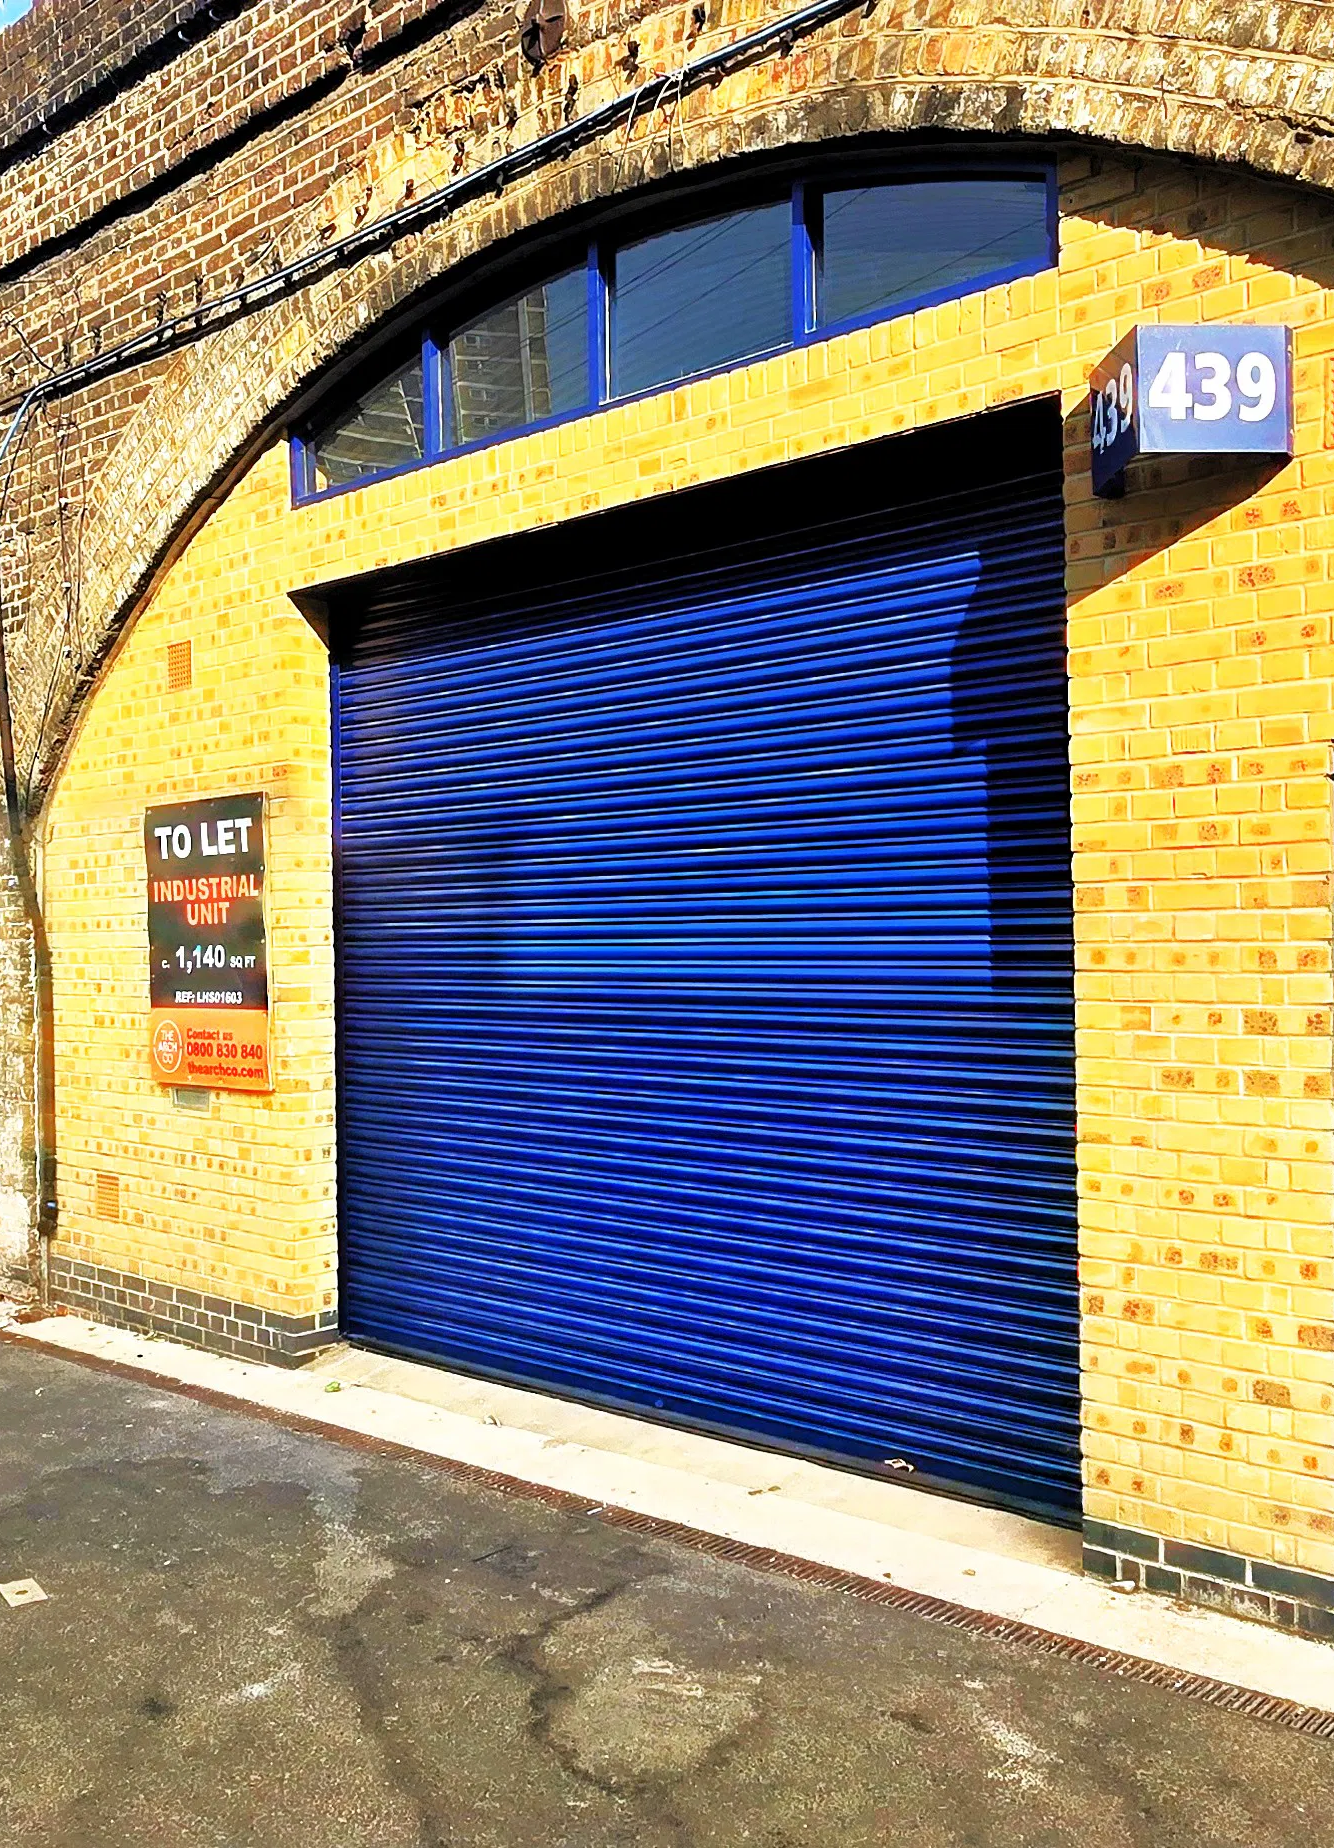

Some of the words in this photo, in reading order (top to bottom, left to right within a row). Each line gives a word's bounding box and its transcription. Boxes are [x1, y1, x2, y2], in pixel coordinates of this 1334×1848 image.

[1149, 351, 1277, 422] 439
[1093, 362, 1133, 454] 439
[154, 824, 192, 860] TO
[200, 817, 253, 857] LET
[153, 874, 259, 902] INDUSTRIAL
[186, 902, 231, 926] UNIT
[175, 944, 226, 974] 1,140
[229, 955, 243, 969] SQ
[244, 955, 256, 969] FT
[174, 990, 196, 1004] REF:
[161, 1029, 175, 1041] THE
[186, 1028, 220, 1041] Contact
[223, 1032, 234, 1041] us
[157, 1041, 178, 1053] ARCH
[186, 1042, 214, 1057] 0800
[216, 1043, 238, 1059] 830
[241, 1044, 264, 1060] 840
[162, 1052, 174, 1064] CO
[187, 1060, 264, 1079] thearchco.com
